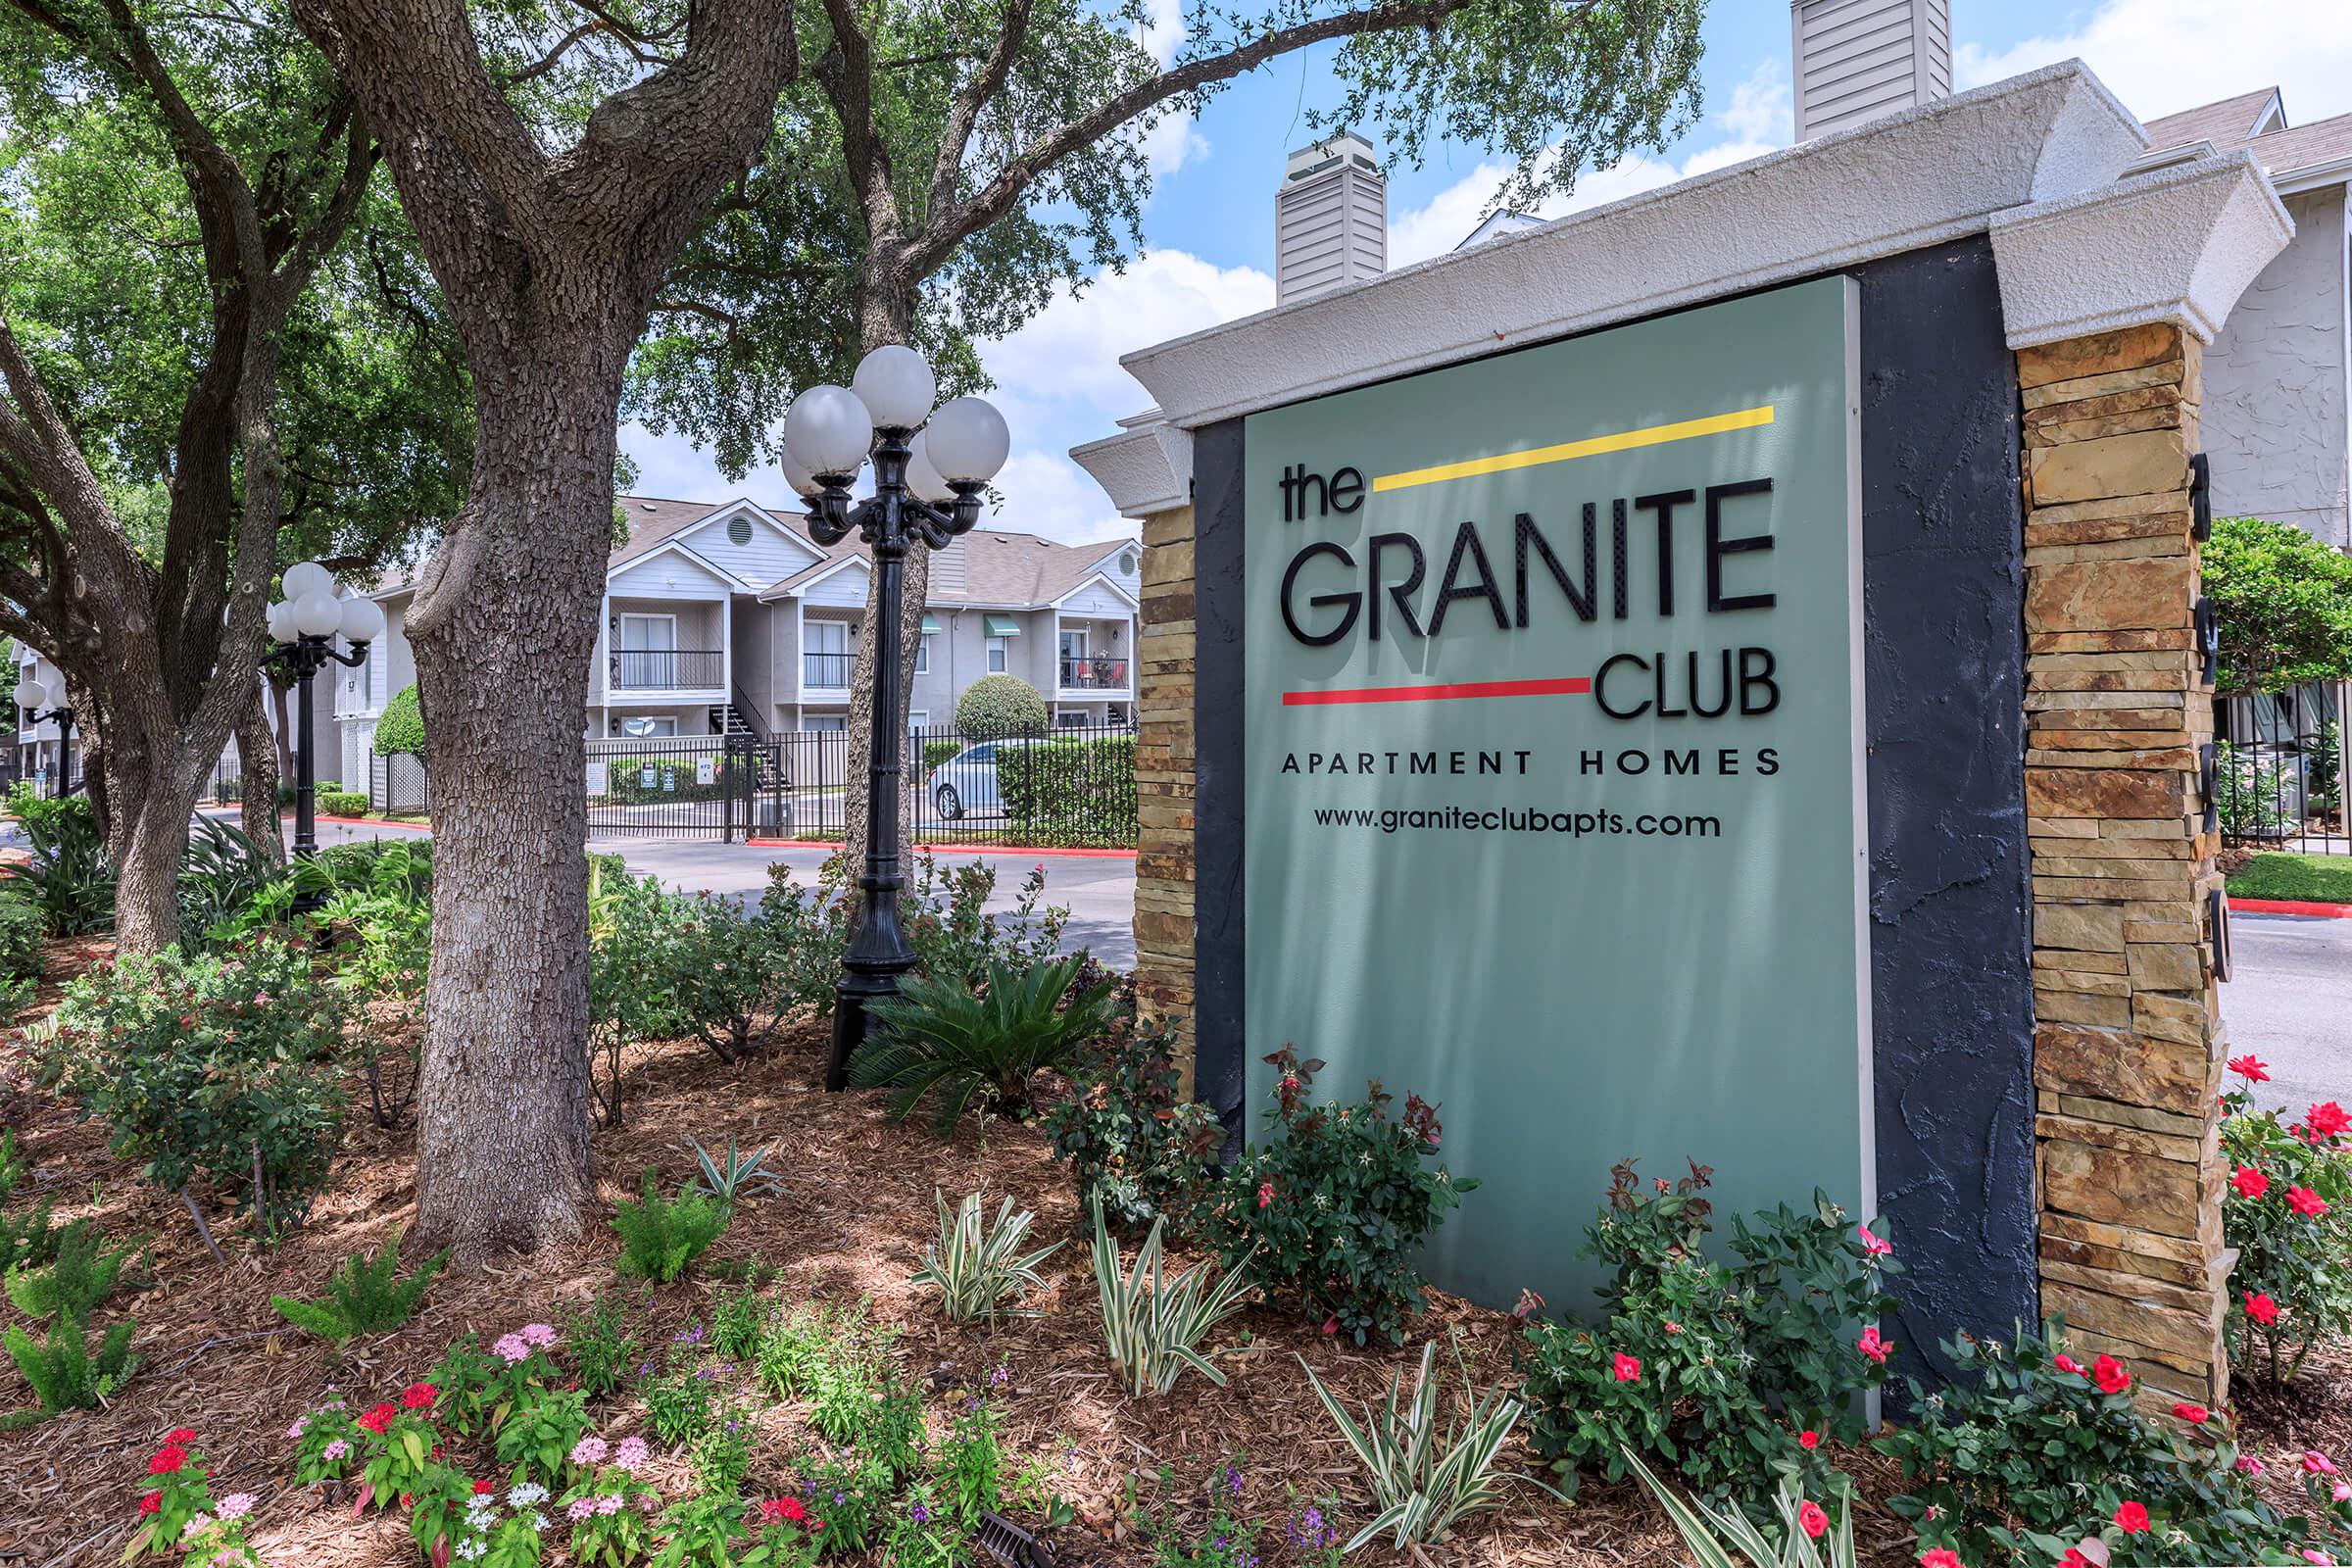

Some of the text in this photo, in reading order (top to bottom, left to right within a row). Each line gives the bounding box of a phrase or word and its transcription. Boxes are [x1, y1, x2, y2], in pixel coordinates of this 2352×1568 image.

[1279, 463, 1366, 522] the
[1280, 476, 1777, 648] GRANITE
[1593, 647, 1782, 721] CLUB
[1281, 748, 1780, 776] APARTMENT HOMES
[1314, 806, 1721, 839] www.graniteclubapts.com
